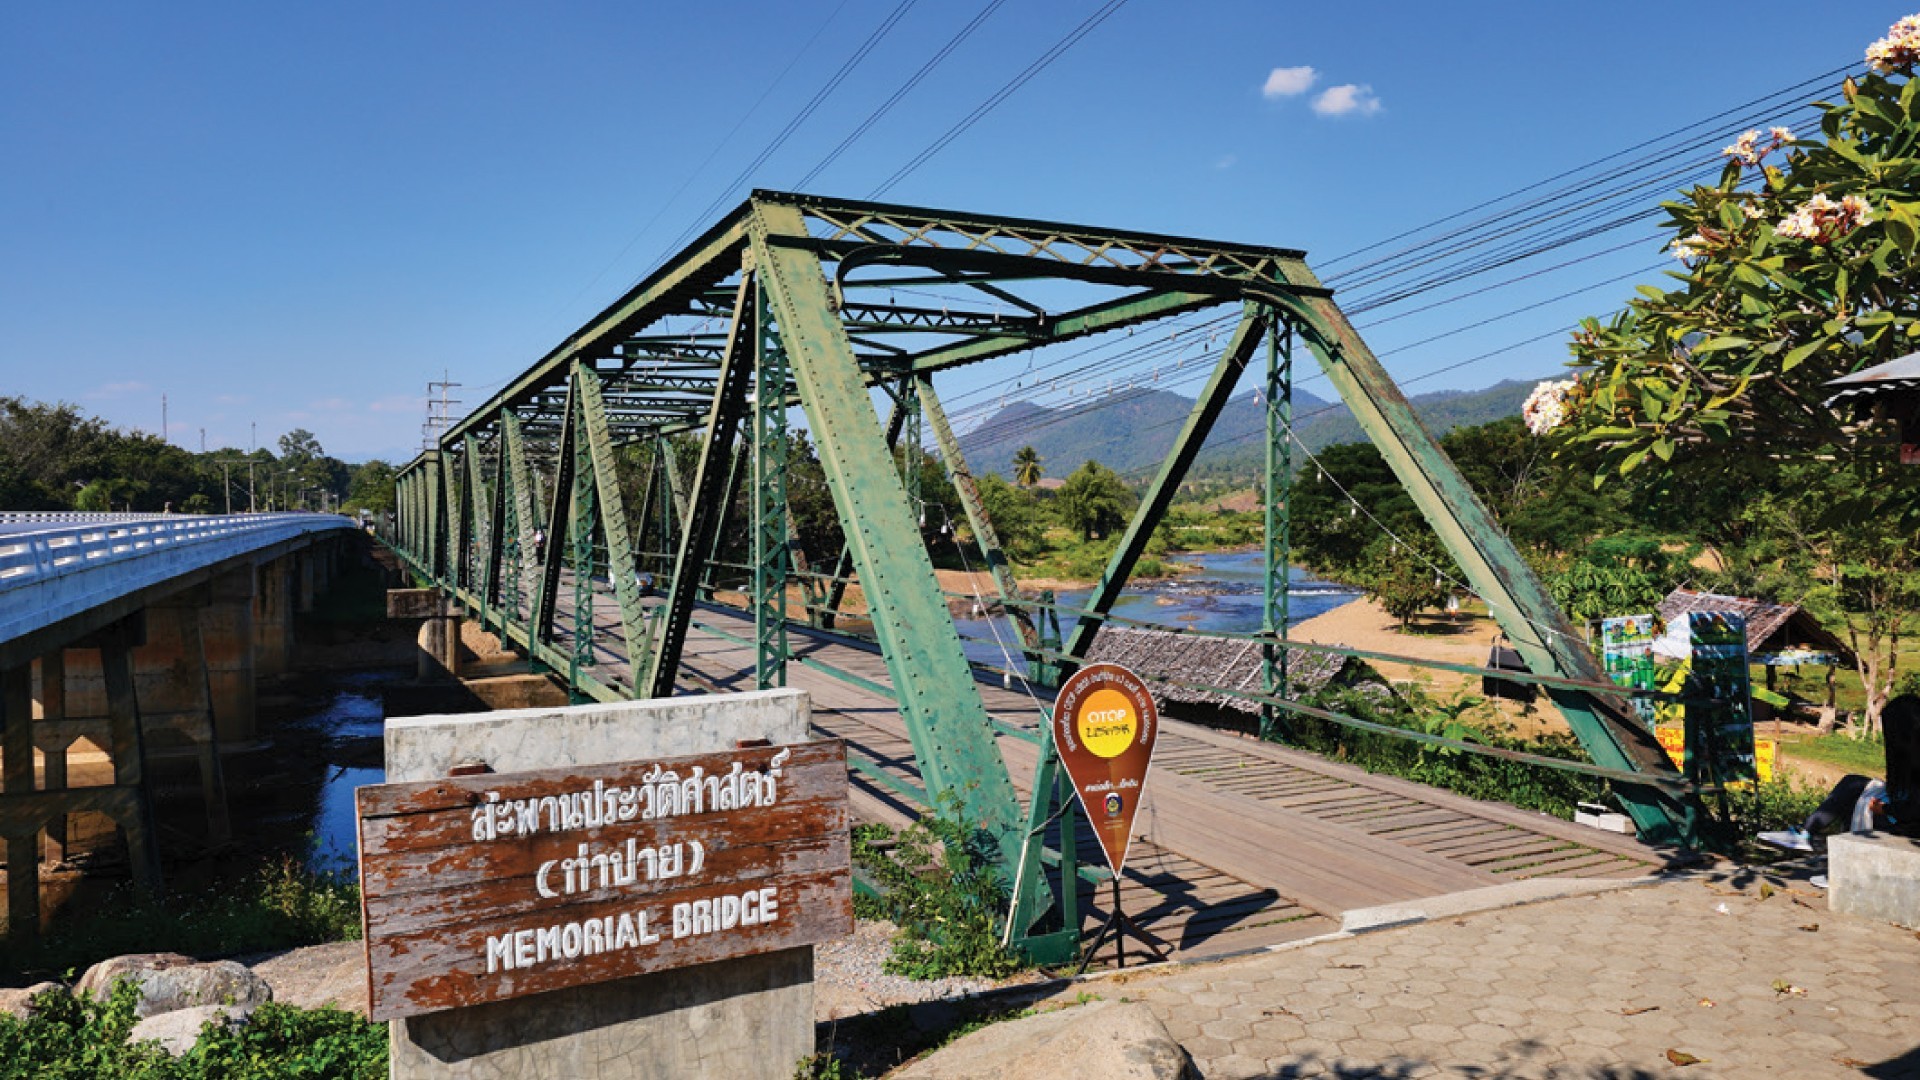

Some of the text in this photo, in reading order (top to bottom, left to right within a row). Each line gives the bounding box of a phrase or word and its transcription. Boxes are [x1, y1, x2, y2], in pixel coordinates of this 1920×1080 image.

[1087, 709, 1127, 723] OTOP
[536, 838, 705, 898] (ท่าปาย)
[486, 887, 779, 974] MEMORIAL BRIDGE
